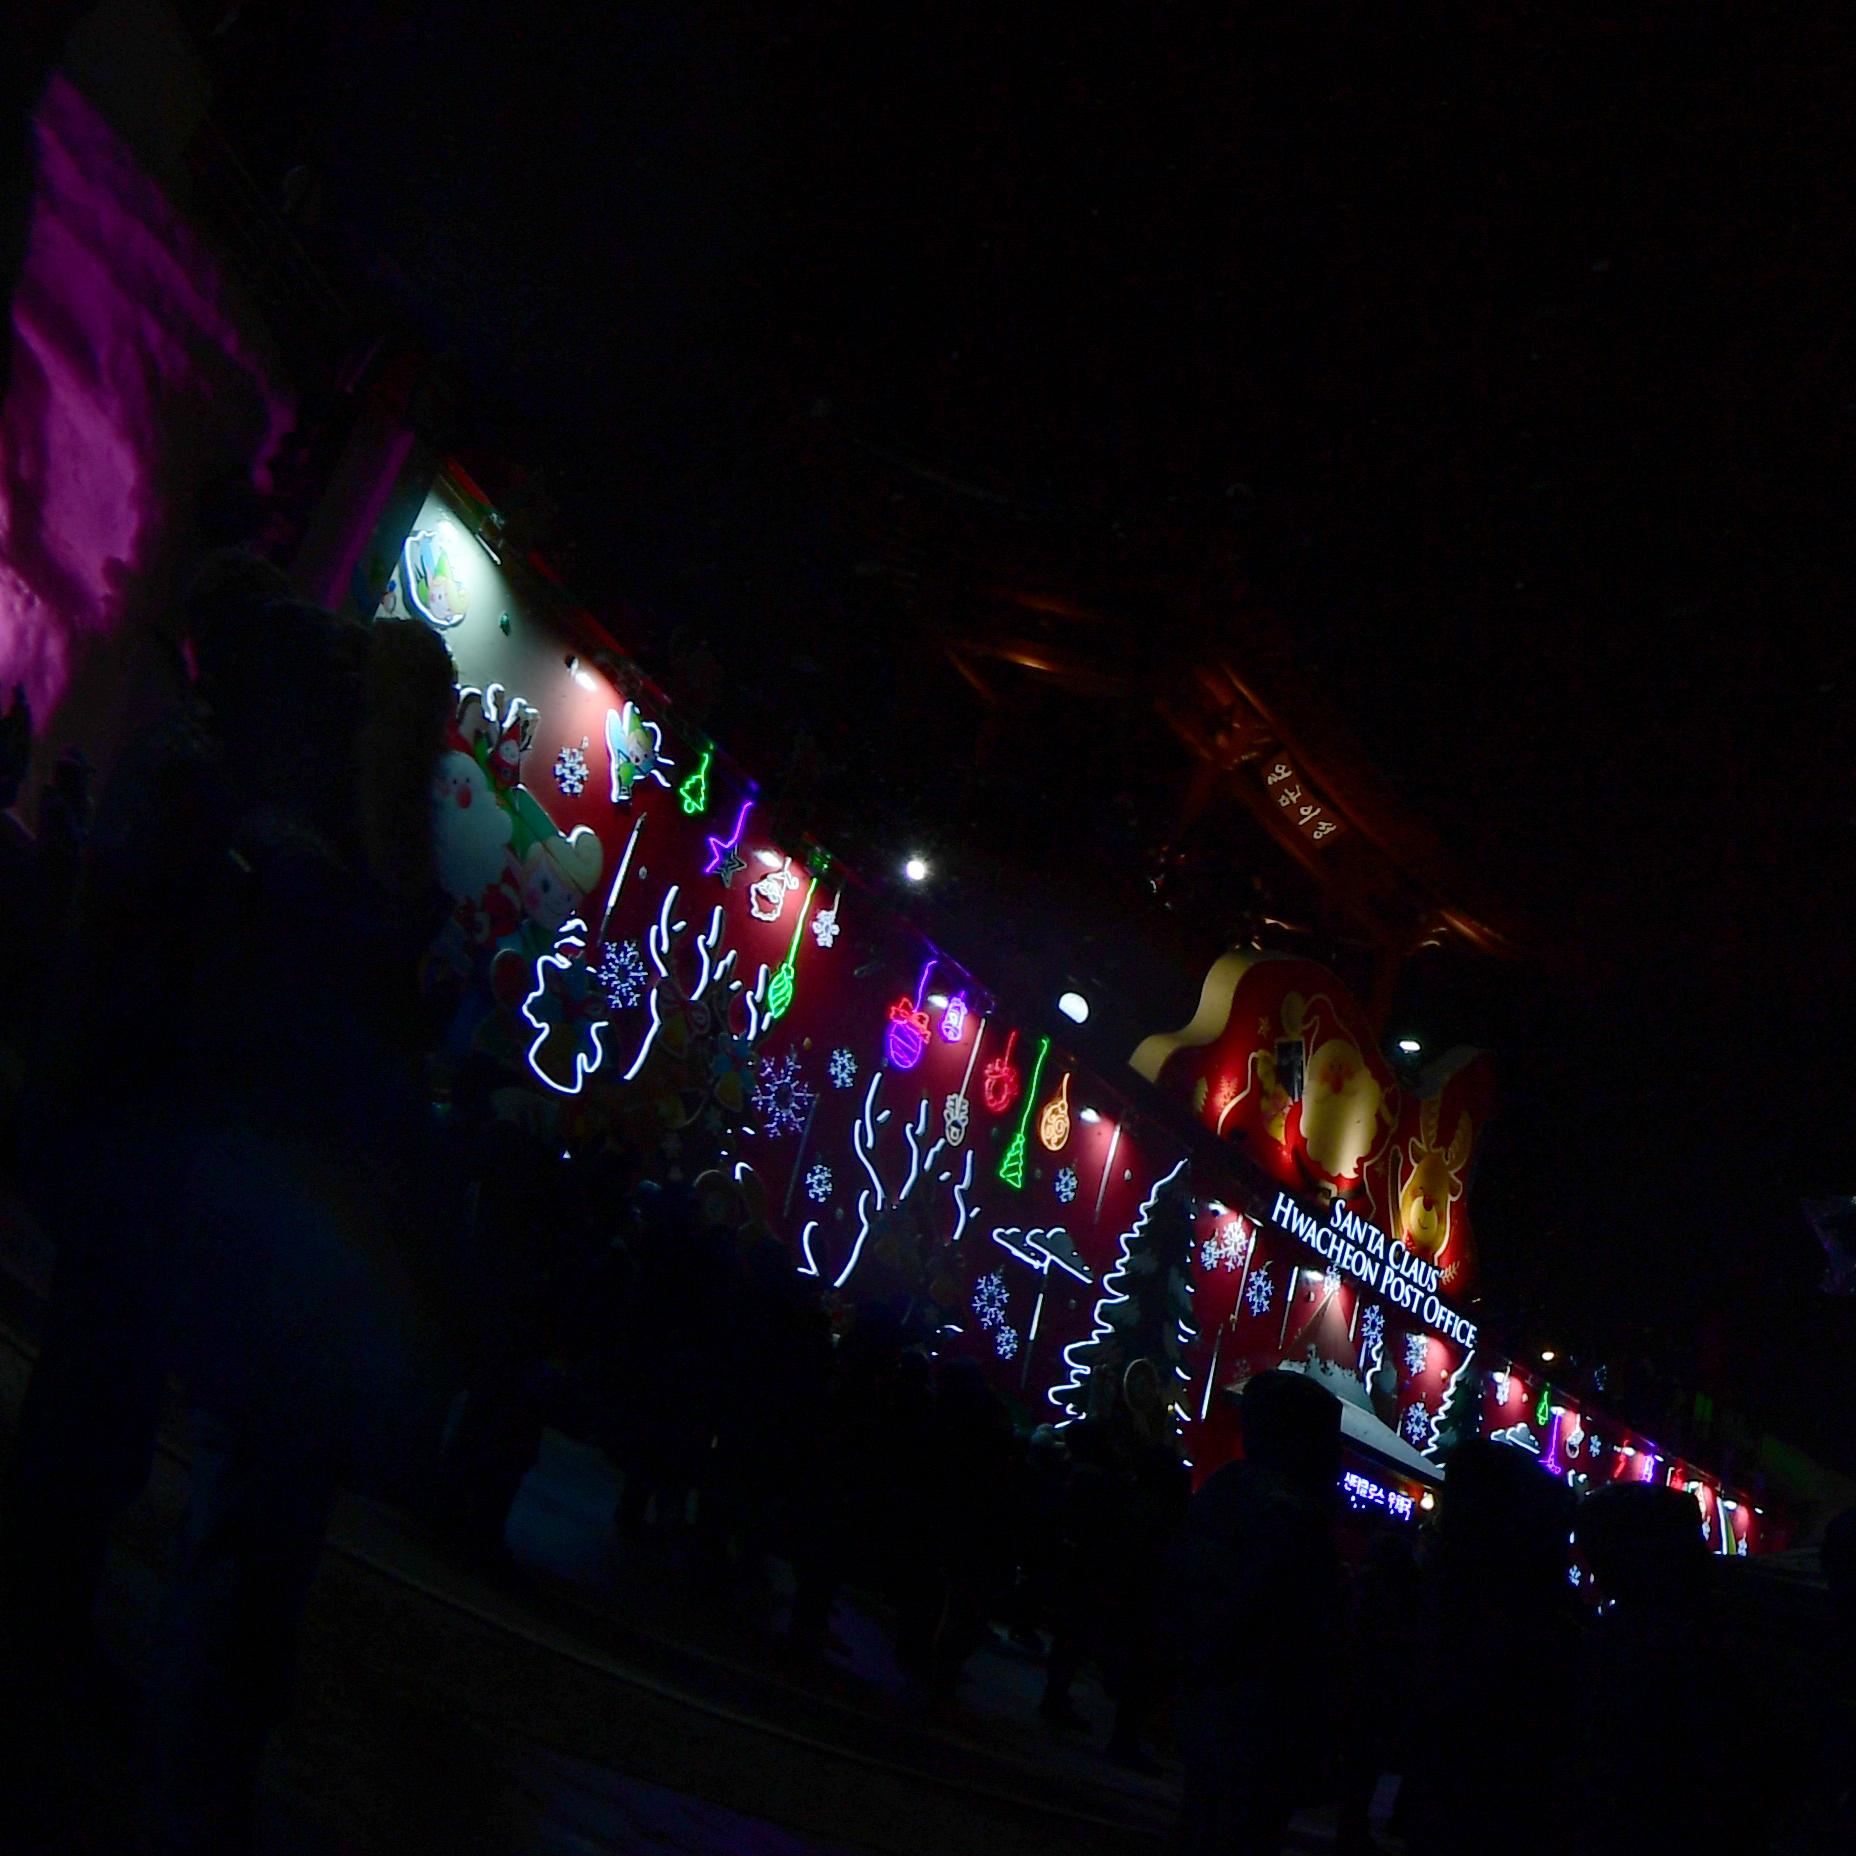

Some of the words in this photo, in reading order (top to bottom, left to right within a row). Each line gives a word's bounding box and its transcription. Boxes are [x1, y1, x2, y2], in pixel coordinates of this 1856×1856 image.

[1267, 763, 1337, 839] 얼곰이성
[1330, 1198, 1385, 1260] SANTA
[1271, 1191, 1380, 1286] HWACHEON
[1380, 1265, 1425, 1314] POST
[1423, 1295, 1478, 1349] OFFICE
